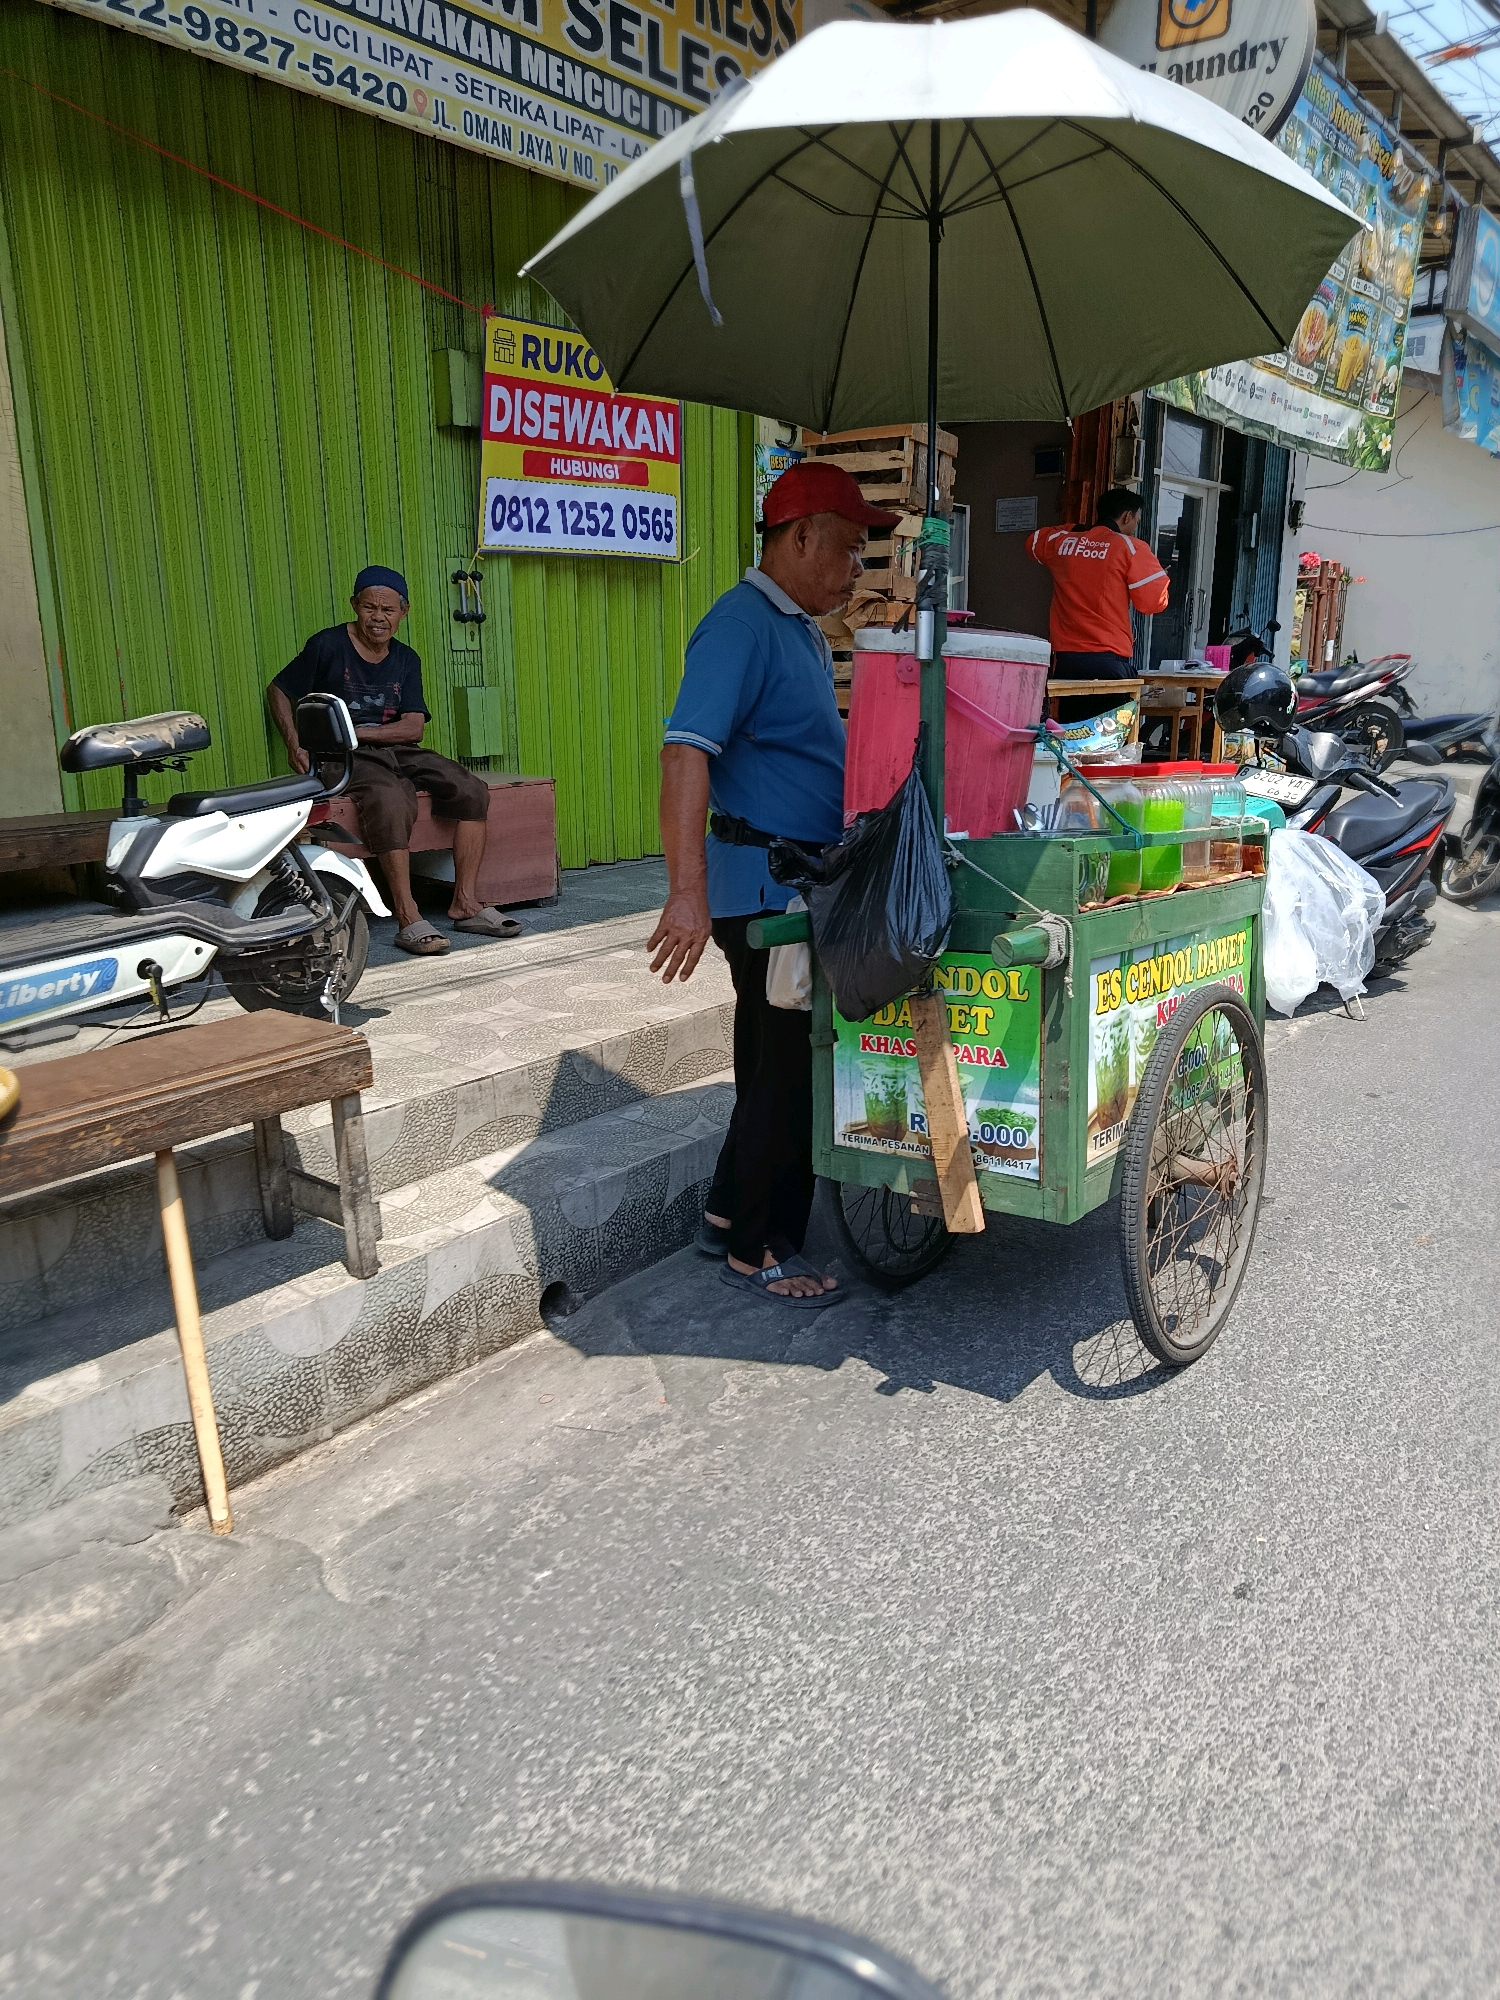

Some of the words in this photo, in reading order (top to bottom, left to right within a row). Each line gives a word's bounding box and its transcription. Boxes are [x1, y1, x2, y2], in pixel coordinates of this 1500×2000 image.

[566, 0, 762, 105] SELES
[293, 8, 358, 54] CUCI
[367, 36, 433, 81] LIPAT
[454, 72, 549, 127] SETRIKA
[553, 114, 605, 147] LIPAT
[621, 137, 649, 160] LA
[520, 41, 650, 131] MENCUCI
[432, 98, 456, 132] JL.
[463, 109, 512, 152] OMAN
[518, 130, 554, 168] JAYA
[559, 144, 568, 171] V
[573, 150, 599, 183] NO.
[521, 333, 604, 381] RUKO
[490, 384, 675, 456] DISEWAKAN
[550, 457, 620, 480] HUBUNGI
[770, 455, 786, 470] BEST
[491, 494, 552, 535] 0812
[556, 499, 616, 537] 1252
[622, 507, 674, 544] 0565
[1075, 545, 1108, 560] Food
[1079, 537, 1110, 549] Shopee
[1240, 767, 1250, 777] B
[1096, 967, 1122, 1015] ES
[1125, 945, 1195, 1004] CENDOL
[1196, 930, 1246, 981] DAWET
[872, 998, 995, 1036] DAET
[860, 1034, 917, 1058] KHAS
[909, 1112, 931, 1139] R
[1092, 1119, 1130, 1151] TERIMA
[841, 1132, 879, 1147] TERIMA
[881, 1138, 930, 1156] PESANAN
[975, 1154, 1001, 1167] 8611
[1005, 1159, 1032, 1172] 4417
